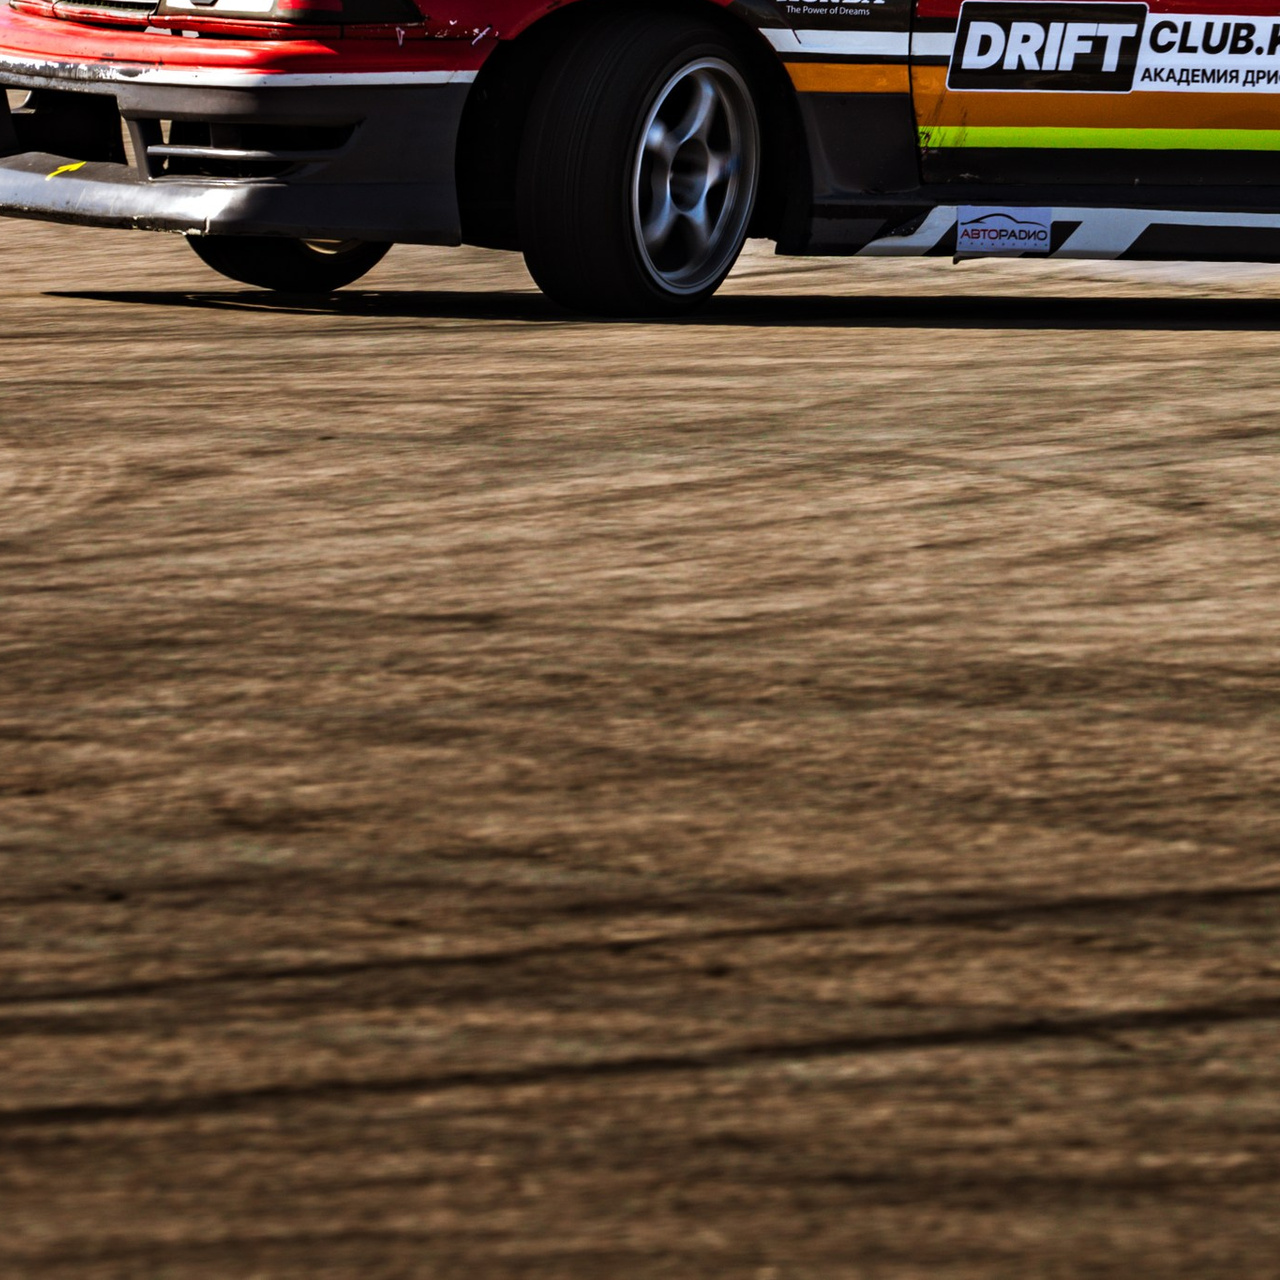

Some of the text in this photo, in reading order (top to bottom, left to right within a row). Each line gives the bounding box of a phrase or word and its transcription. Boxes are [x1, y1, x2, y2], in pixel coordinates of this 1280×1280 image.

[786, 5, 870, 16] The Power of Dreams
[961, 21, 1138, 73] DRIFT
[1141, 68, 1240, 86] АКАДЕМИЯ
